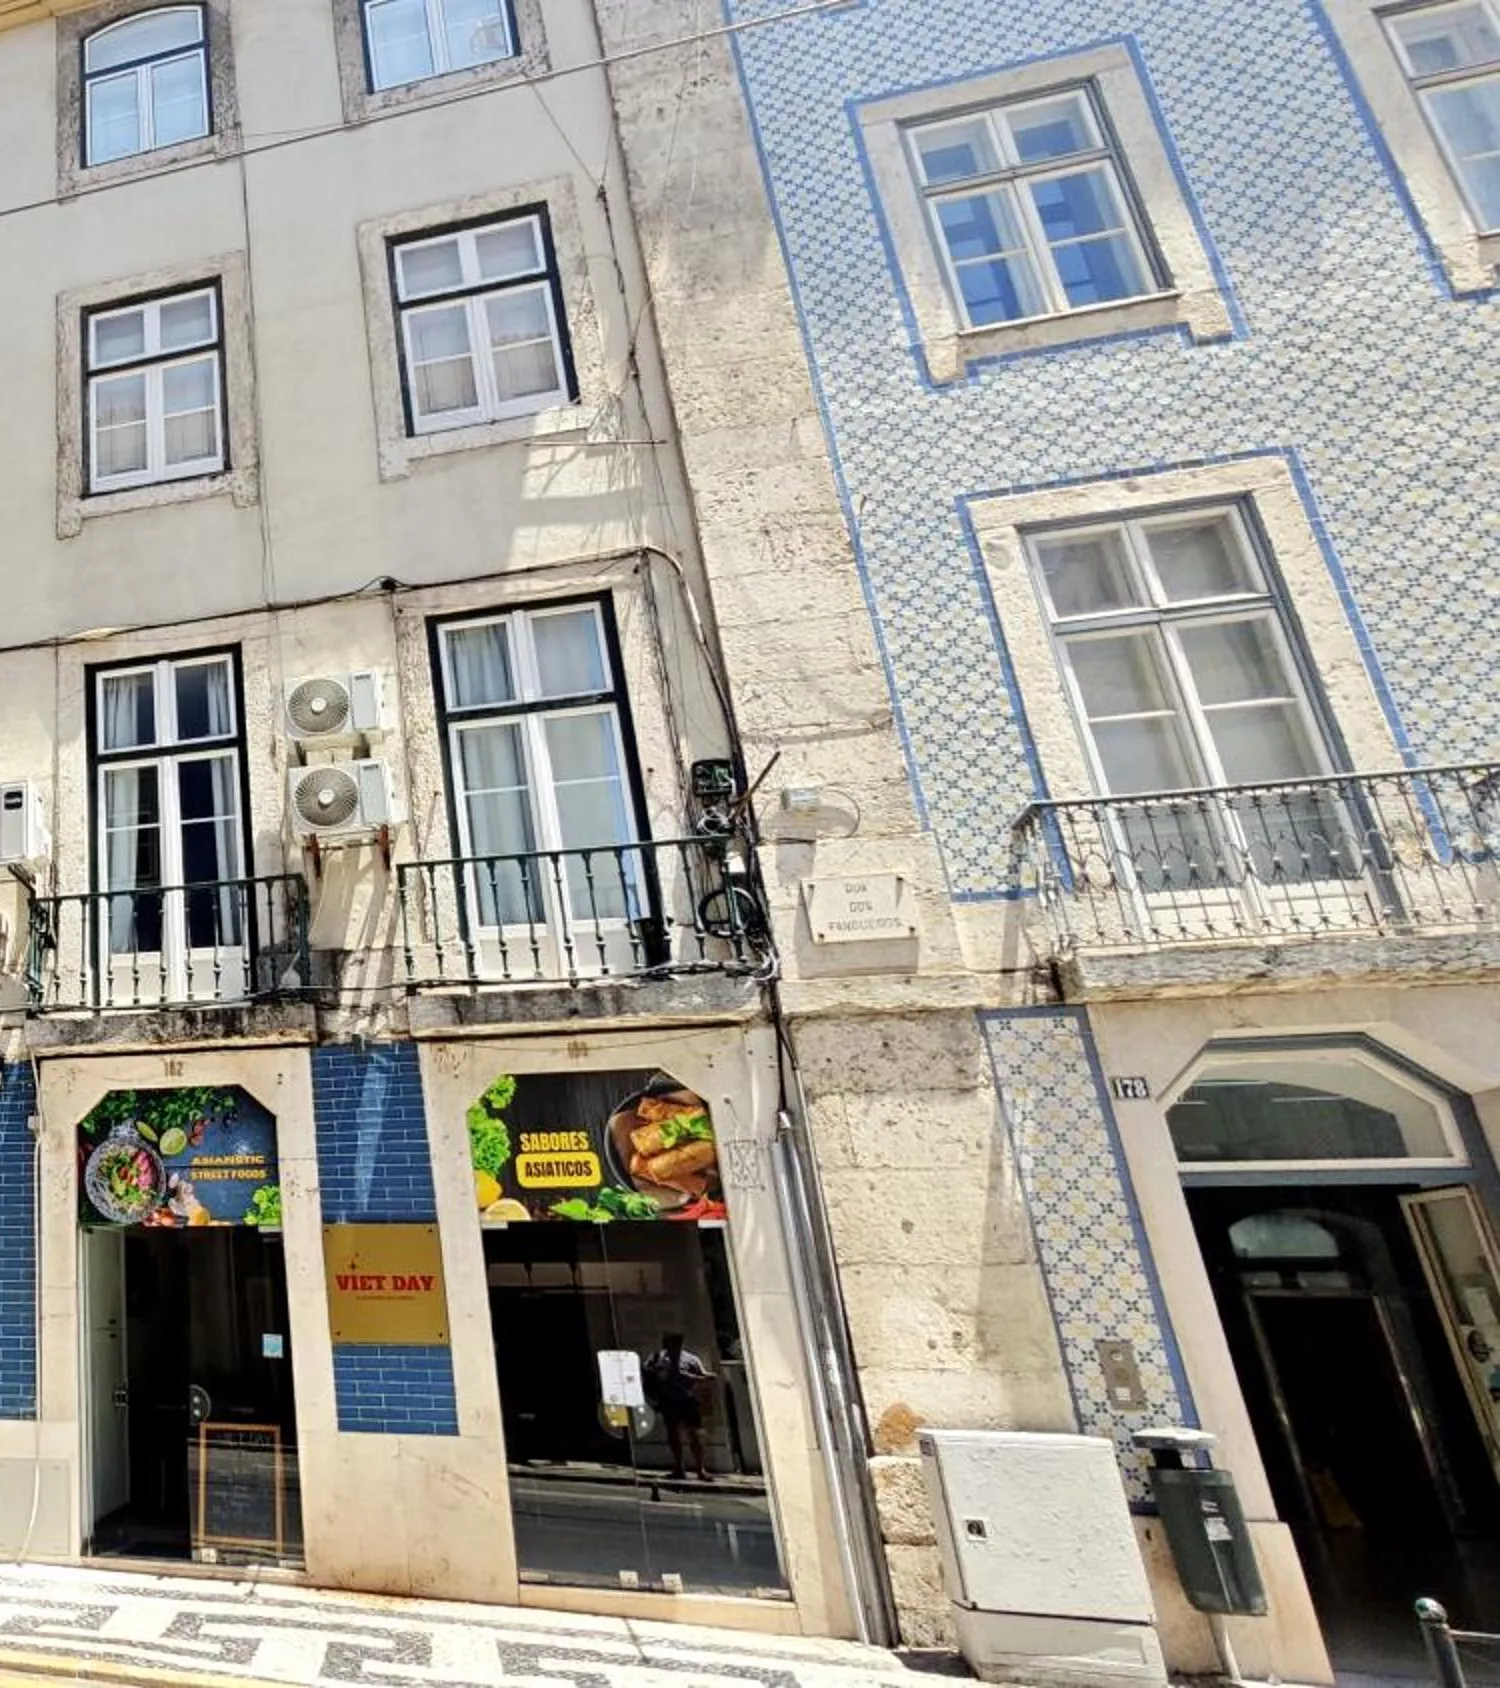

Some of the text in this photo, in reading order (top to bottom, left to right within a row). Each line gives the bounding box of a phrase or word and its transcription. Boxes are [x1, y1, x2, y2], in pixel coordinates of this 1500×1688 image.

[1114, 1079, 1148, 1098] 178
[519, 1131, 589, 1152] SABORES
[230, 1169, 267, 1179] FOODS
[525, 1160, 593, 1178] ASIATICOS
[336, 1275, 434, 1291] VIET DAY
